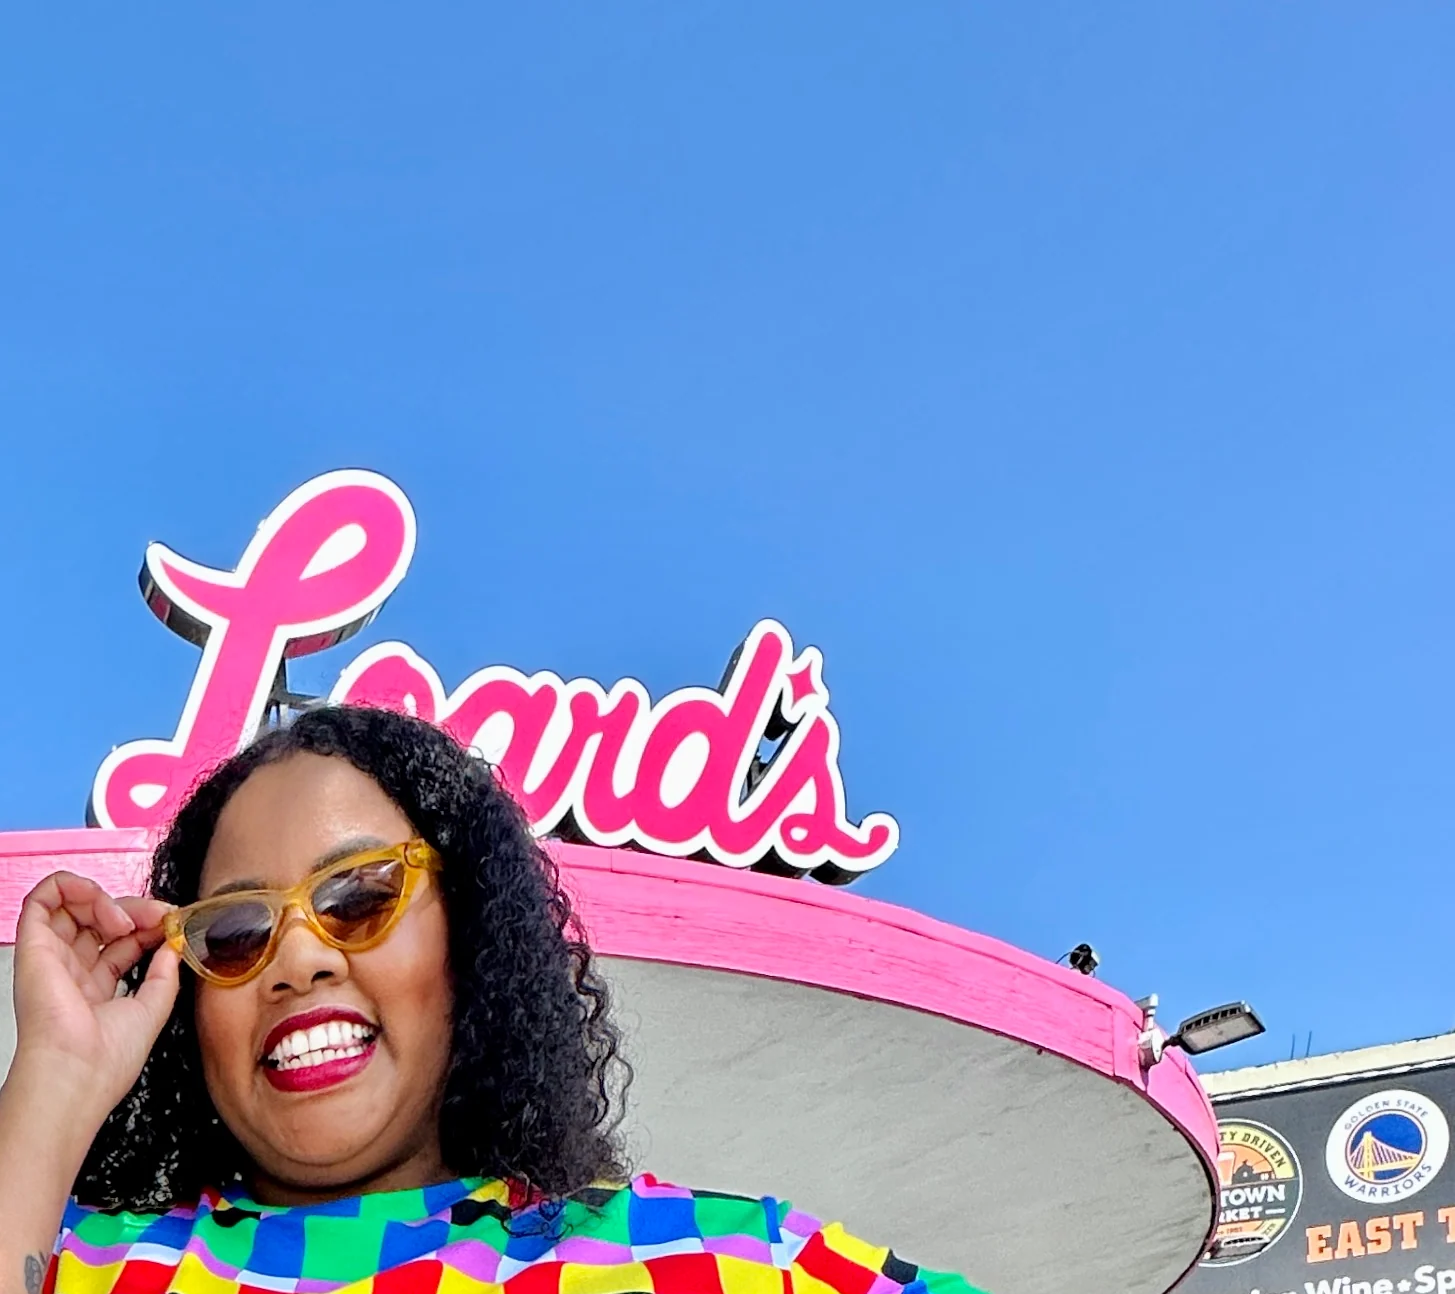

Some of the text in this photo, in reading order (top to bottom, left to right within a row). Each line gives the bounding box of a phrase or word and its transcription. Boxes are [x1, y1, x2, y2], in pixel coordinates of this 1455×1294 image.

[1344, 1098, 1429, 1131] GOLDEN STATE
[1241, 1132, 1287, 1168] DRIVEN
[1343, 1162, 1433, 1198] WARRIORS
[1305, 1210, 1425, 1264] EAST
